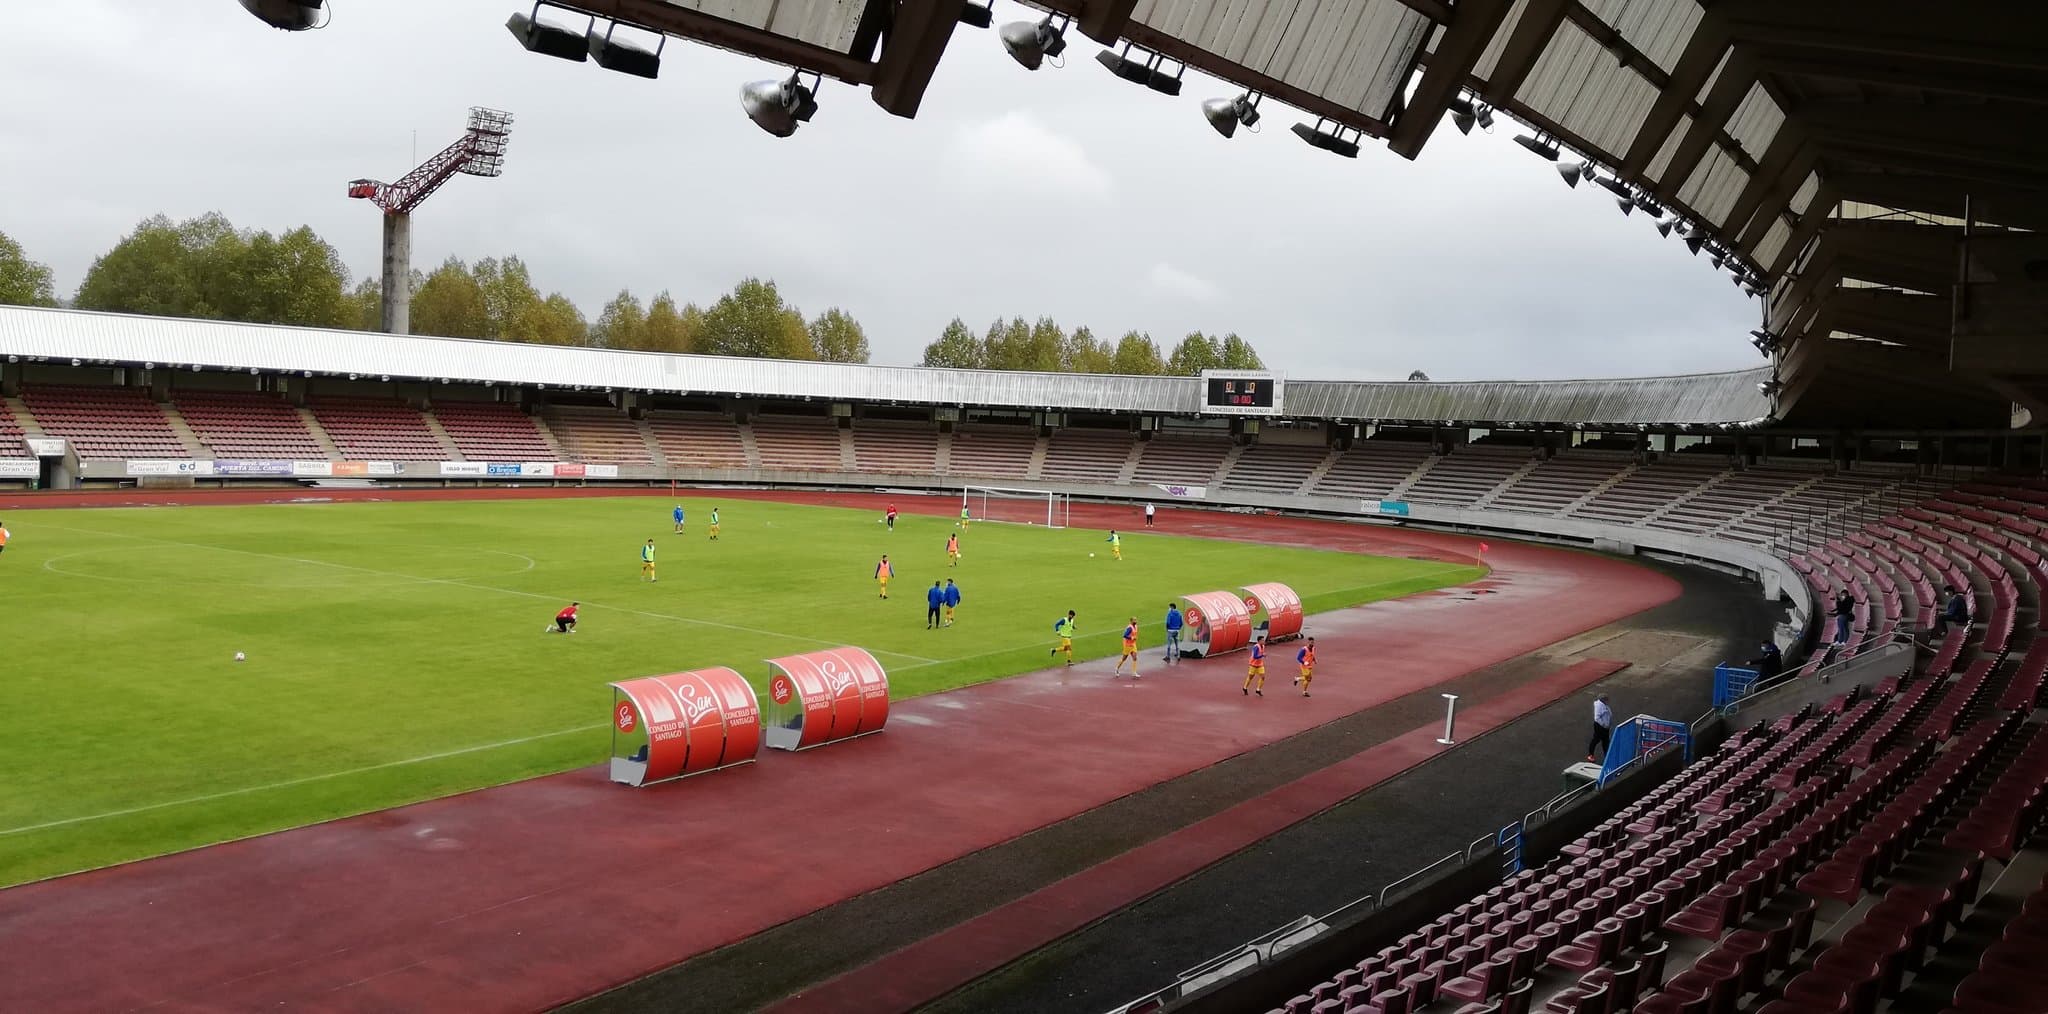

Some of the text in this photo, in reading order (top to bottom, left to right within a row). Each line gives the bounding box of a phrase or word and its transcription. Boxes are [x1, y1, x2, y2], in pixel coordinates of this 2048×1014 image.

[823, 661, 855, 696] San
[775, 680, 788, 700] San
[678, 684, 717, 724] San
[808, 702, 829, 711] SANTIAGO
[619, 706, 633, 728] San
[725, 710, 750, 720] CONCELLO
[730, 716, 754, 727] SANTIAGO
[650, 724, 677, 734] CONCELLO
[655, 730, 682, 741] SANTIAGO
